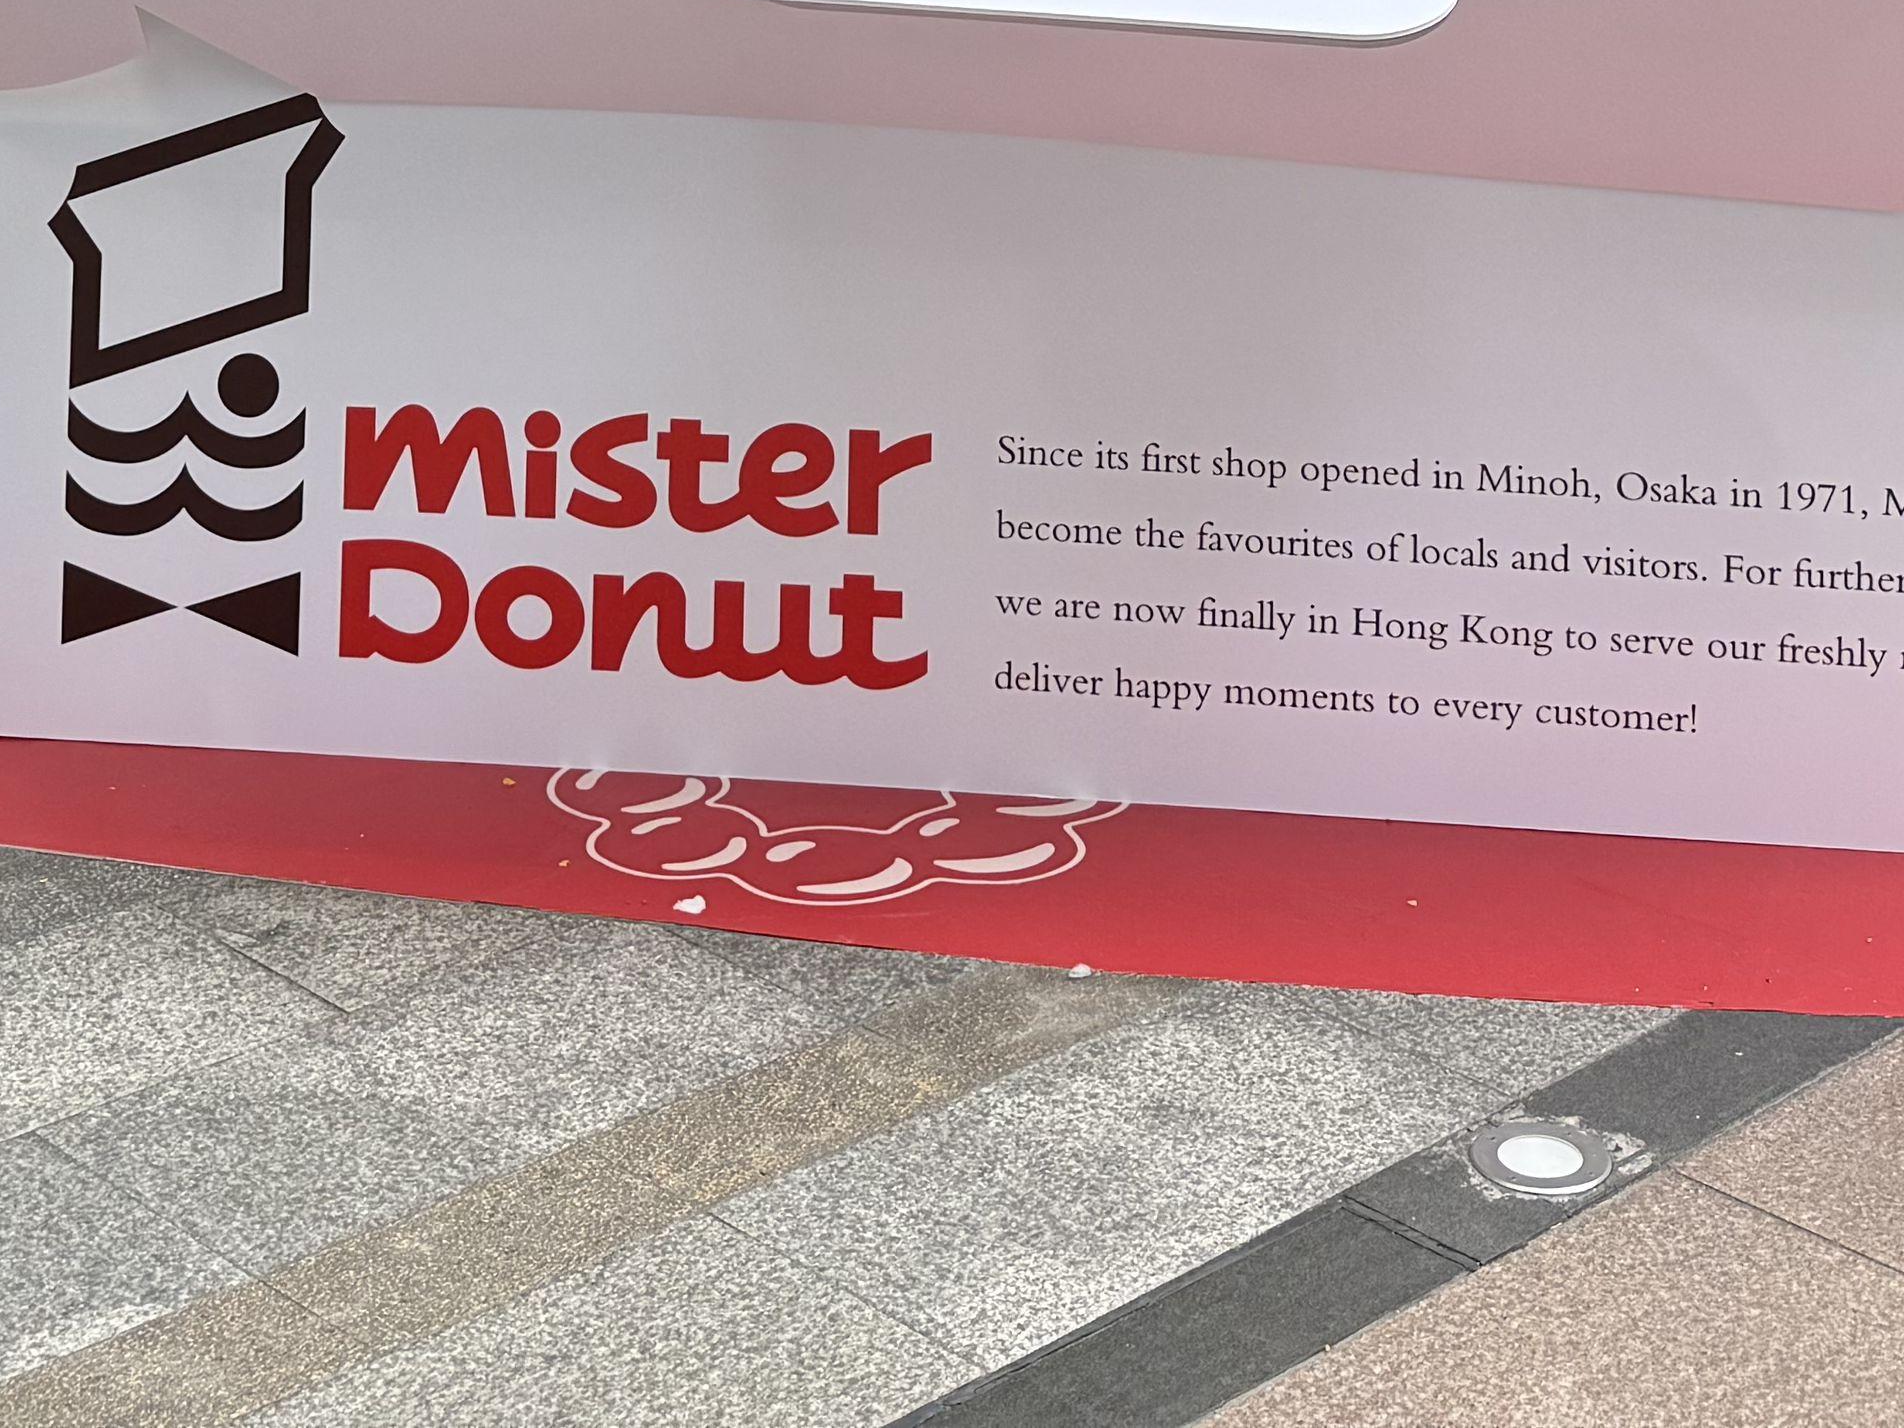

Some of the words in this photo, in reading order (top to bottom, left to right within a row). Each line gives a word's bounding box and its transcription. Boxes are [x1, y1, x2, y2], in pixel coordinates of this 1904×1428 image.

[997, 435, 1084, 469] Since
[1094, 440, 1129, 471] its
[1140, 442, 1201, 475] first
[1211, 446, 1287, 489] shop
[1300, 457, 1421, 493] opened
[1431, 460, 1465, 491] in
[1476, 463, 1601, 505] Minoh,
[1616, 471, 1718, 507] Osaka
[1729, 478, 1763, 509] in
[1777, 480, 1869, 521] 1971,
[995, 508, 1123, 546] become
[1135, 517, 1185, 550] the
[1196, 520, 1354, 560] favourites
[1366, 532, 1406, 563] of
[1409, 533, 1499, 569] locals
[1511, 542, 1571, 573] and
[1581, 546, 1708, 582] visitors.
[1723, 554, 1783, 587] For
[337, 536, 928, 693] Donut
[994, 595, 1042, 617] we
[1054, 598, 1101, 620] are
[1113, 602, 1187, 625] now
[1196, 596, 1297, 641] finally
[1307, 603, 1340, 635] in
[1351, 607, 1449, 651] Hong
[1459, 614, 1554, 657] Kong
[1565, 626, 1597, 651] to
[1609, 632, 1694, 657] serve
[1707, 639, 1767, 662] our
[1777, 632, 1888, 678] freshly
[994, 660, 1104, 697] deliver
[1114, 666, 1213, 712] happy
[1223, 684, 1375, 713] moments
[1388, 691, 1420, 716] to
[1433, 698, 1524, 731] every
[1535, 703, 1697, 734] customer!
